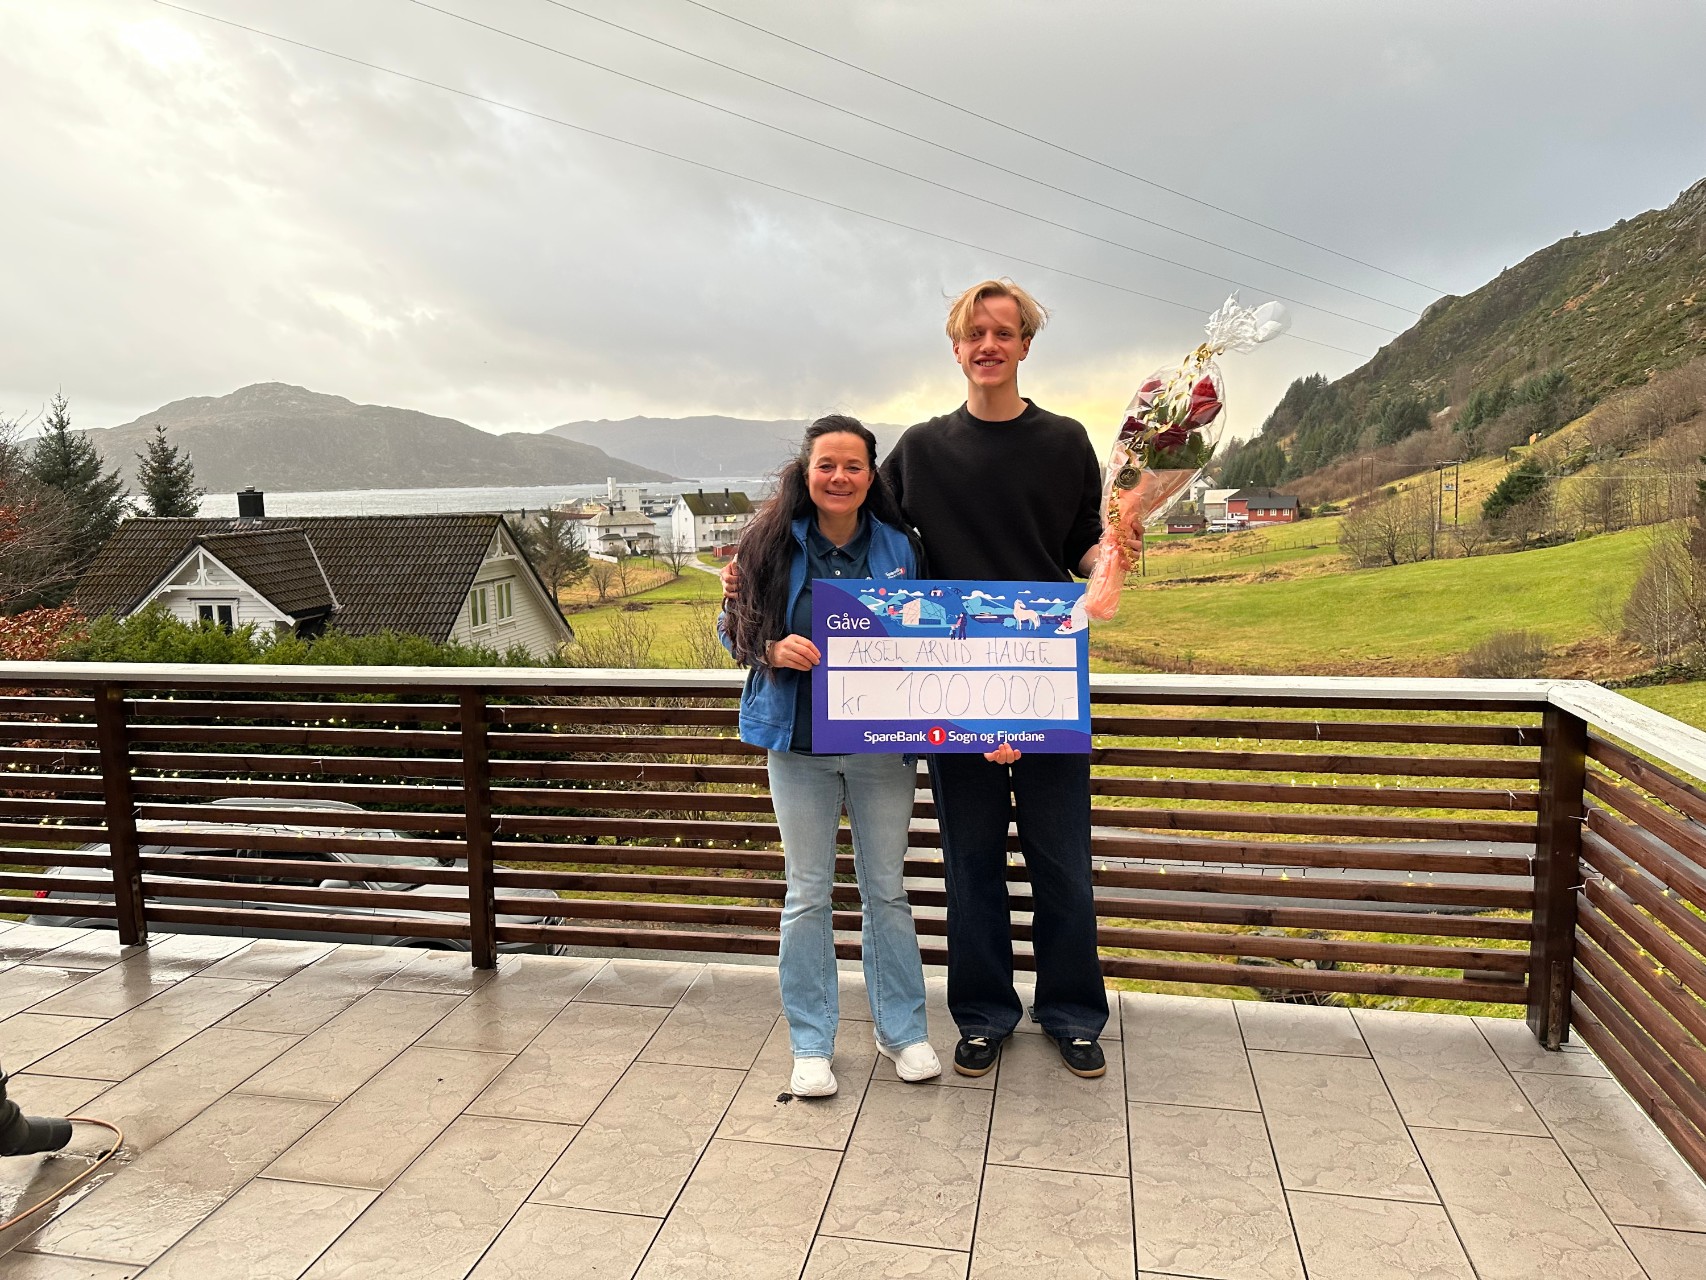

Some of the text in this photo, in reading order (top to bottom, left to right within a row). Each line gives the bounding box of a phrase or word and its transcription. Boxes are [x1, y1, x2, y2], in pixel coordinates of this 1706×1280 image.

[826, 612, 871, 630] Gåve
[848, 637, 1053, 666] AKSEL ARVID HAUGE
[841, 676, 867, 715] kr
[896, 672, 971, 717] 100
[863, 731, 927, 745] SpareBank
[948, 731, 977, 744] Sogn
[980, 733, 995, 744] og
[997, 731, 1045, 744] Fjordane
